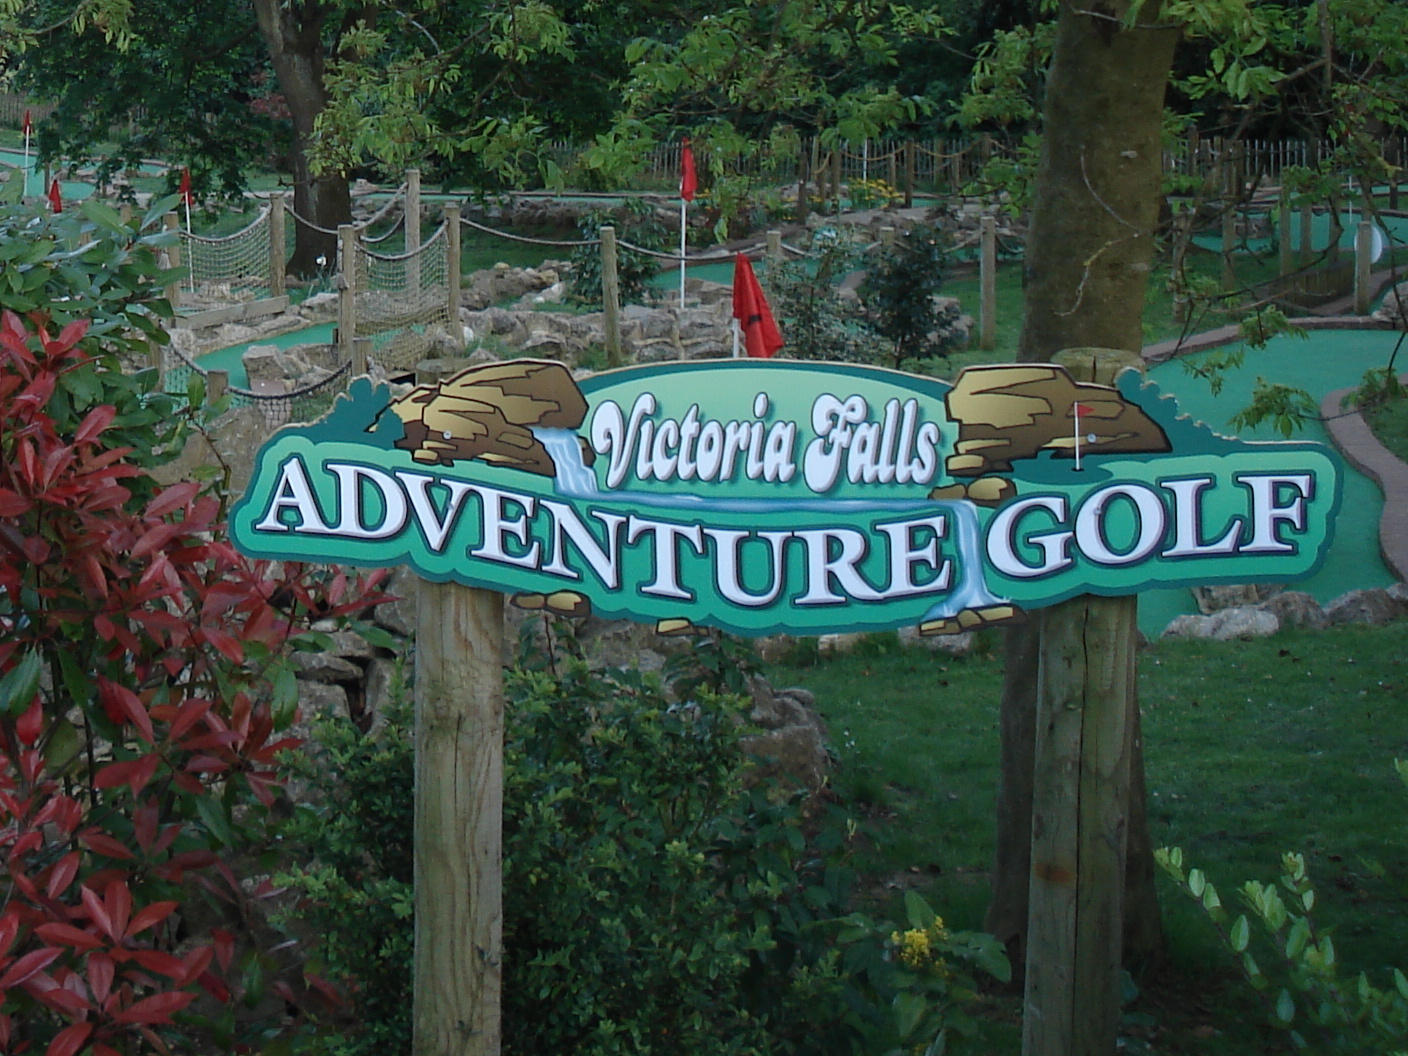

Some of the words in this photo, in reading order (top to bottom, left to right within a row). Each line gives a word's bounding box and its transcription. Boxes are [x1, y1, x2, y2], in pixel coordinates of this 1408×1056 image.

[591, 391, 796, 489] Victoria
[803, 392, 941, 493] Falls
[255, 456, 952, 607] ADVENTURE
[986, 474, 1311, 578] GOLF
